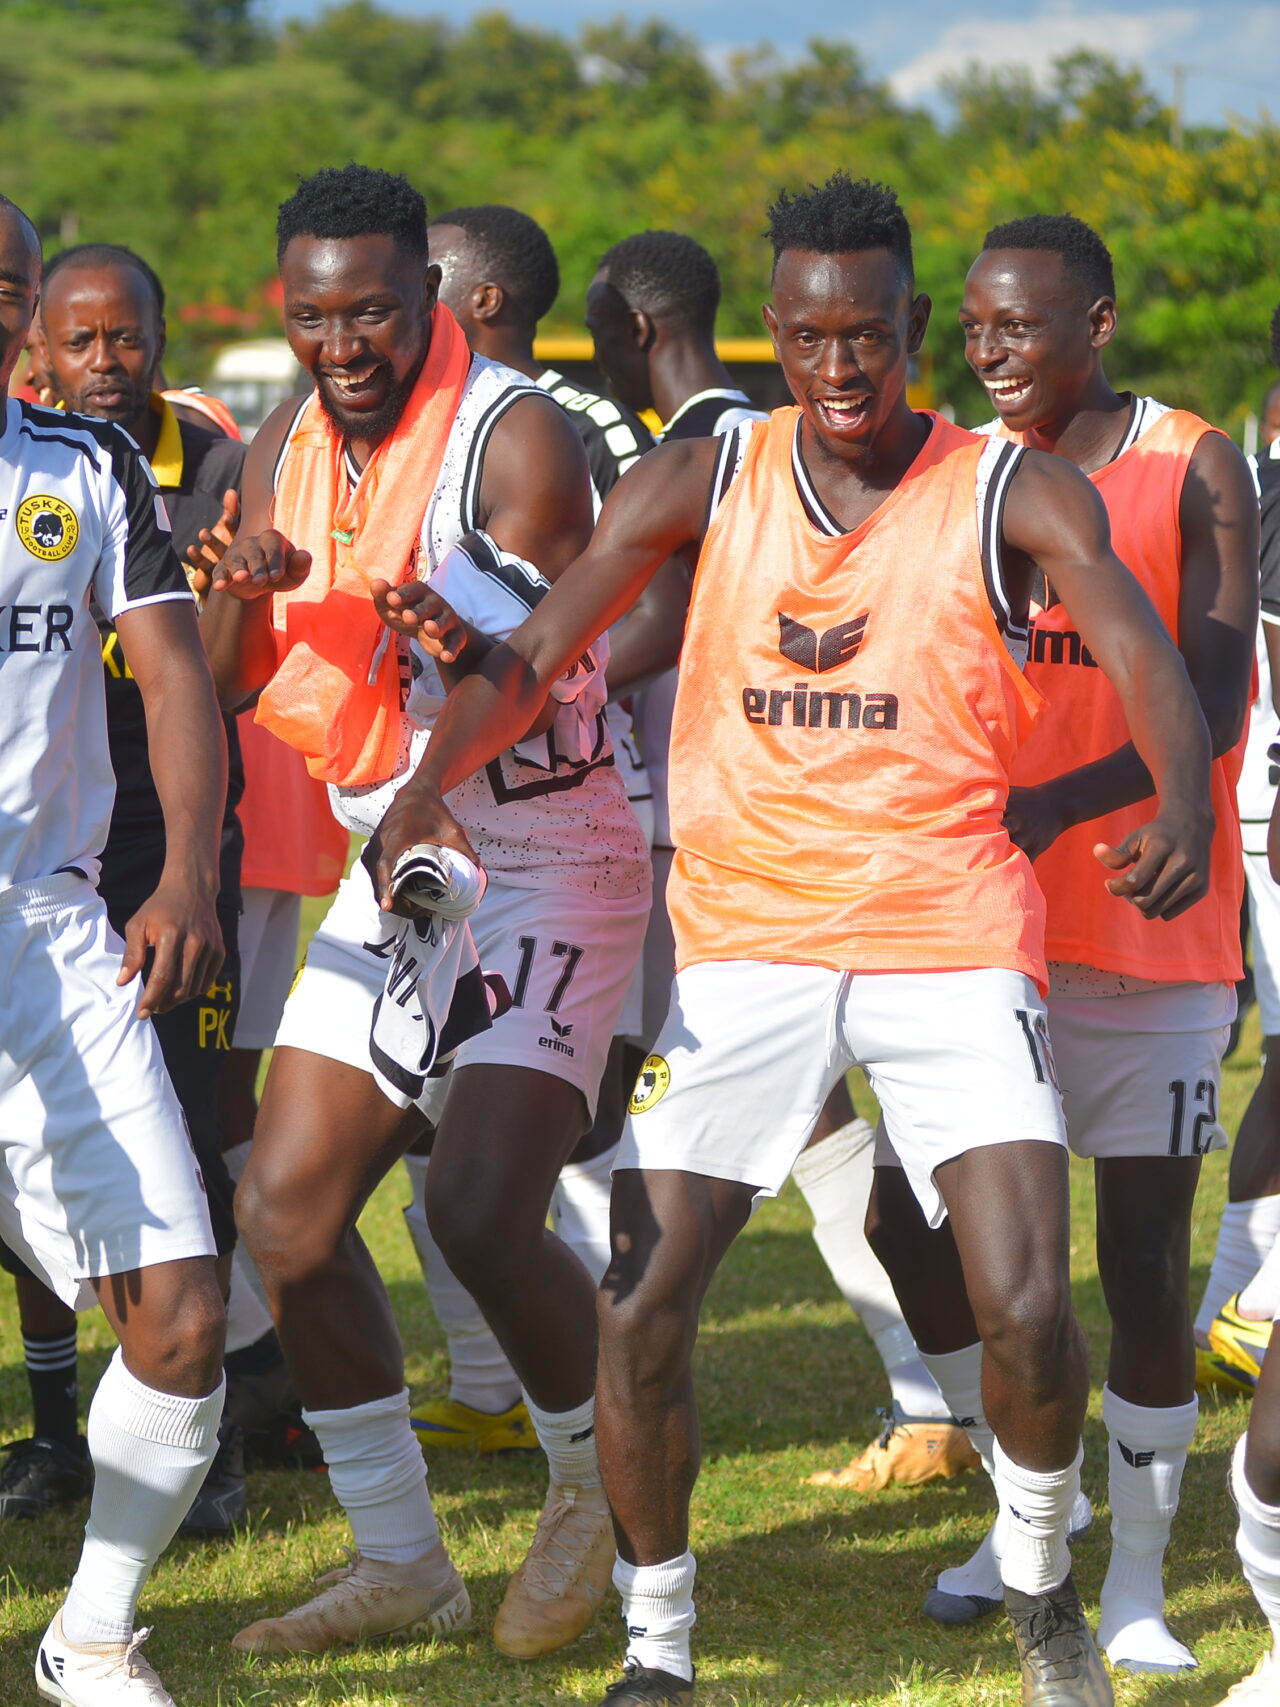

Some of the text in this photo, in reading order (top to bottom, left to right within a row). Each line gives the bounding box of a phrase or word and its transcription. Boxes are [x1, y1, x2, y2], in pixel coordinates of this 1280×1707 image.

[20, 500, 73, 524] TUSKER
[25, 535, 74, 557] FOOTBALL CLUB
[742, 683, 899, 730] erima
[512, 935, 585, 1014] 17
[199, 1007, 231, 1051] PK
[538, 1036, 575, 1057] erima
[1169, 1079, 1217, 1157] 12
